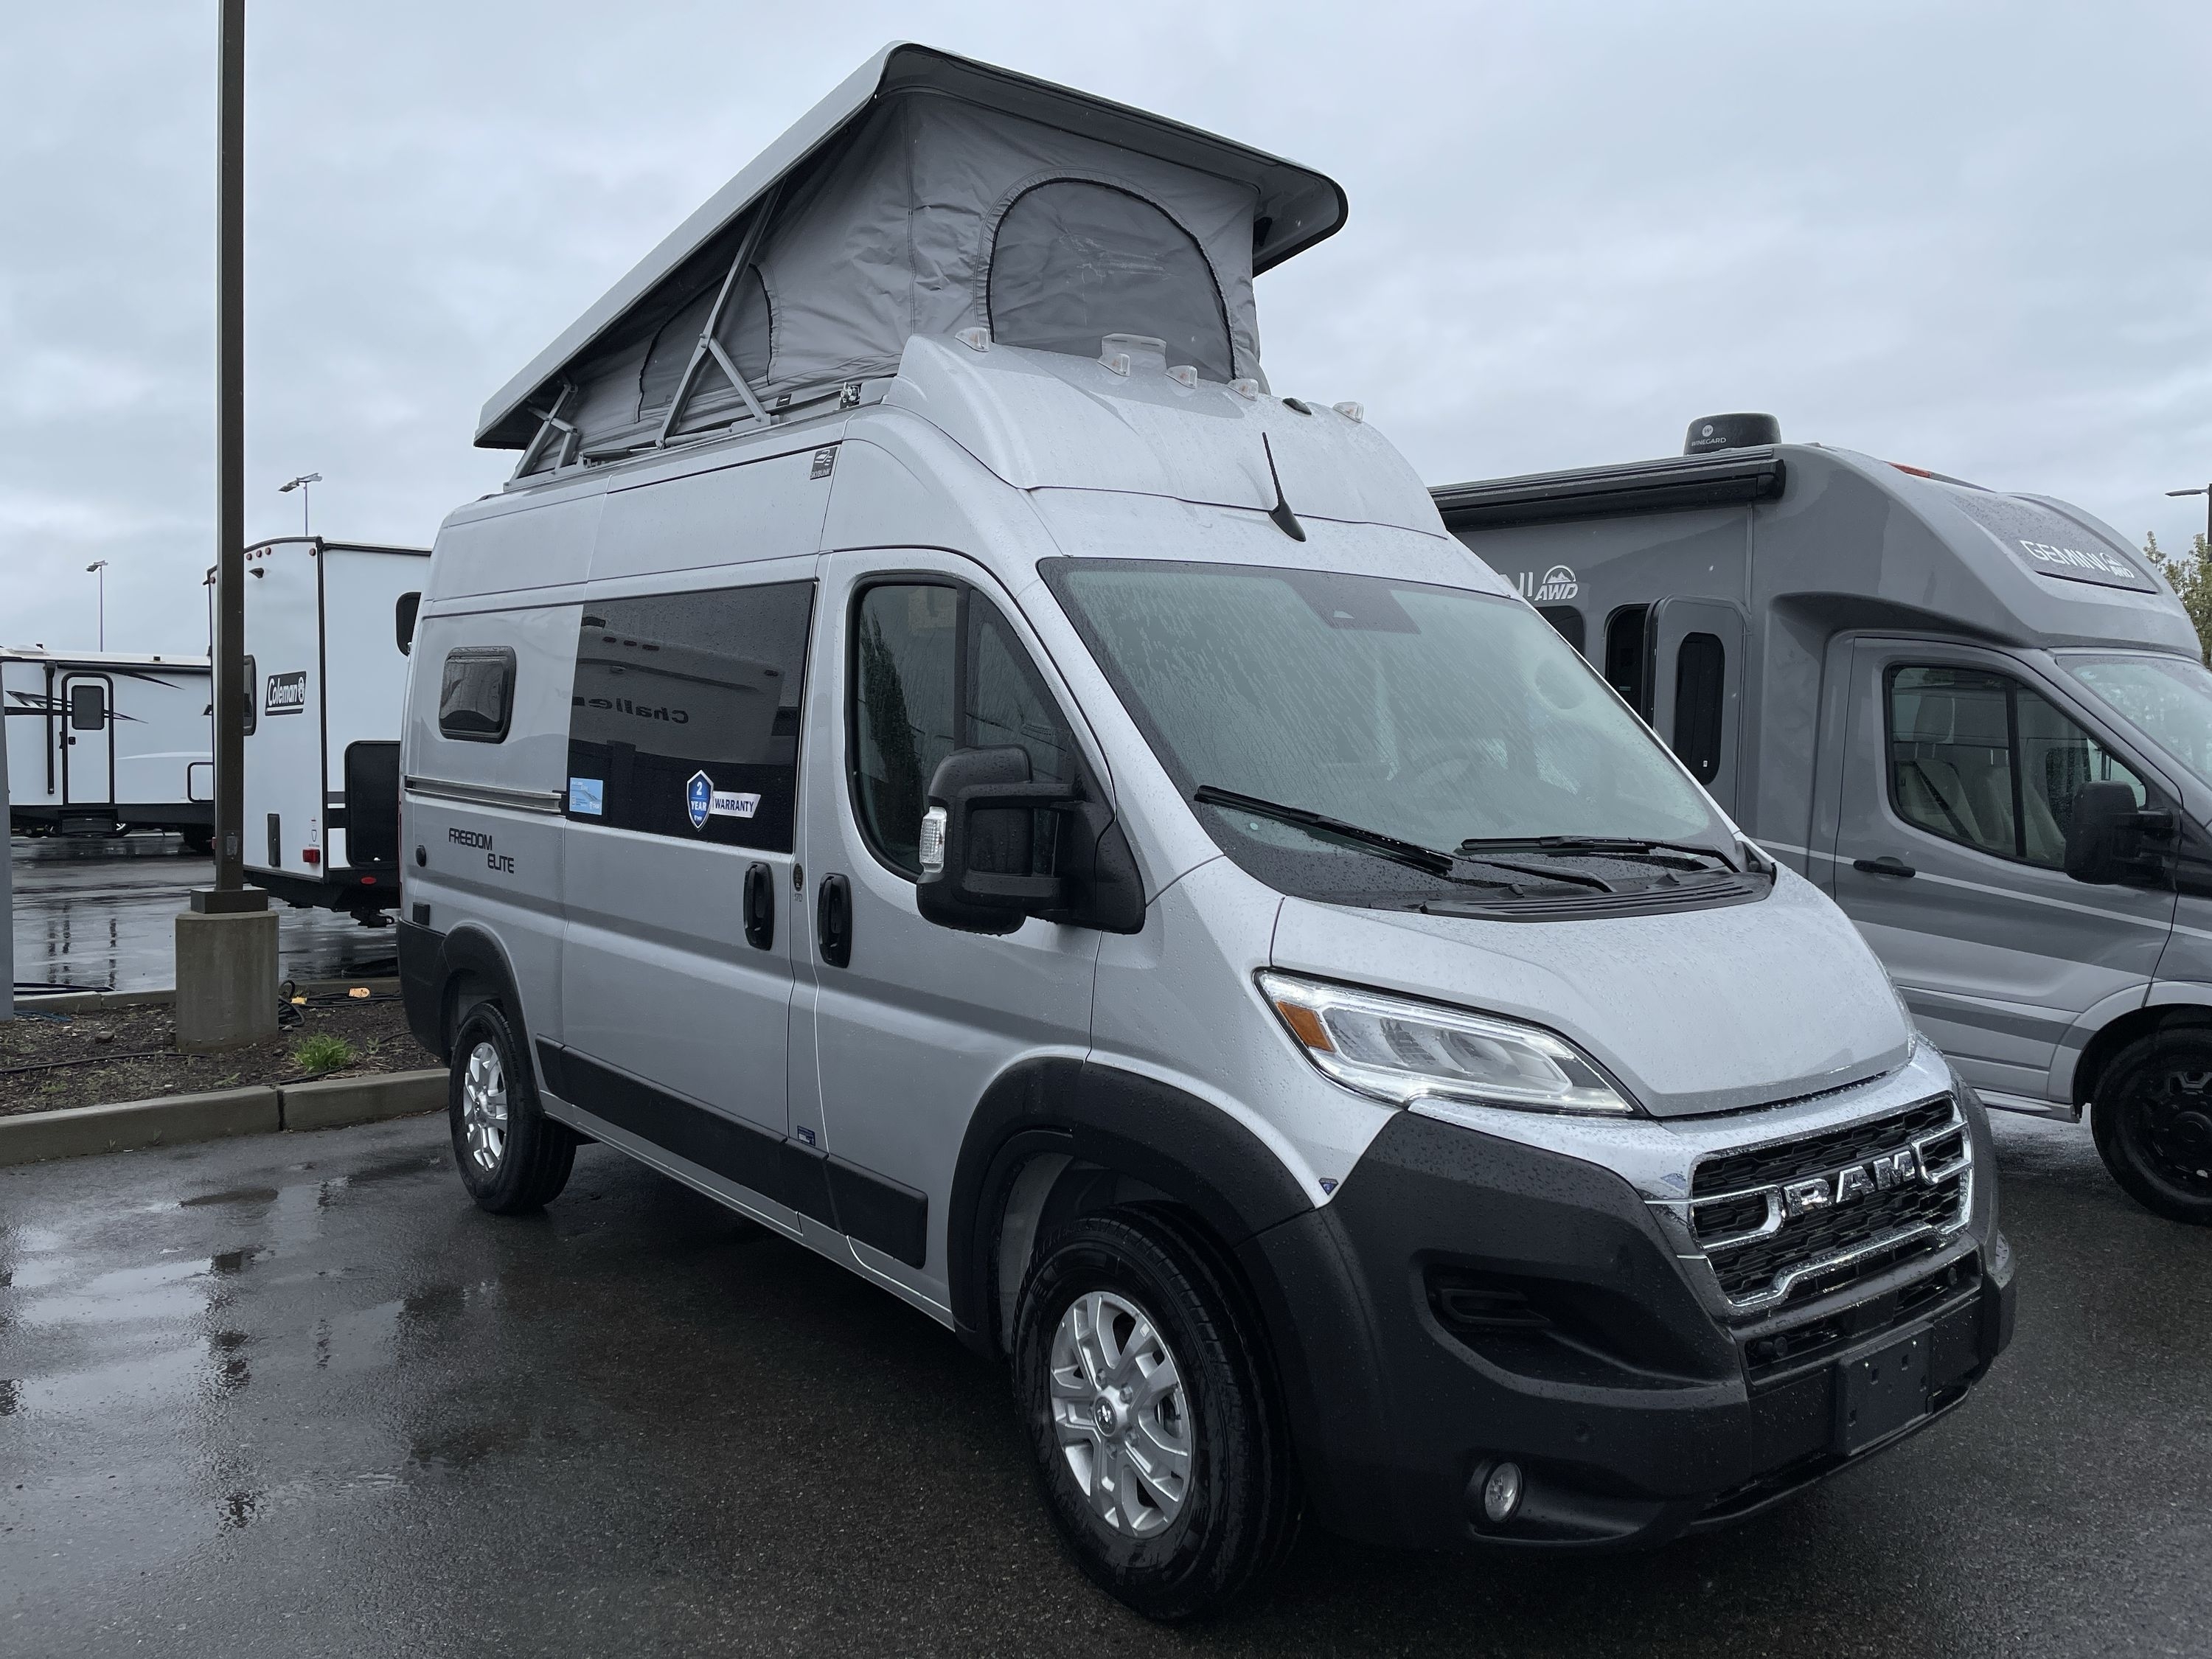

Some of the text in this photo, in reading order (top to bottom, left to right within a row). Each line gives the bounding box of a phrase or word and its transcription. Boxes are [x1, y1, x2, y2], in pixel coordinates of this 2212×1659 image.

[1691, 437, 1727, 447] WINEGARD
[2019, 540, 2135, 579] GEMINI AWD
[1534, 582, 1579, 601] AWD
[268, 678, 298, 706] Coleman
[696, 781, 703, 796] 2
[691, 800, 707, 812] YEAR
[714, 798, 754, 813] WARRANTY
[448, 827, 493, 851] FREEDOM
[487, 852, 515, 874] ELITE
[1784, 1150, 1916, 1217] RAM
